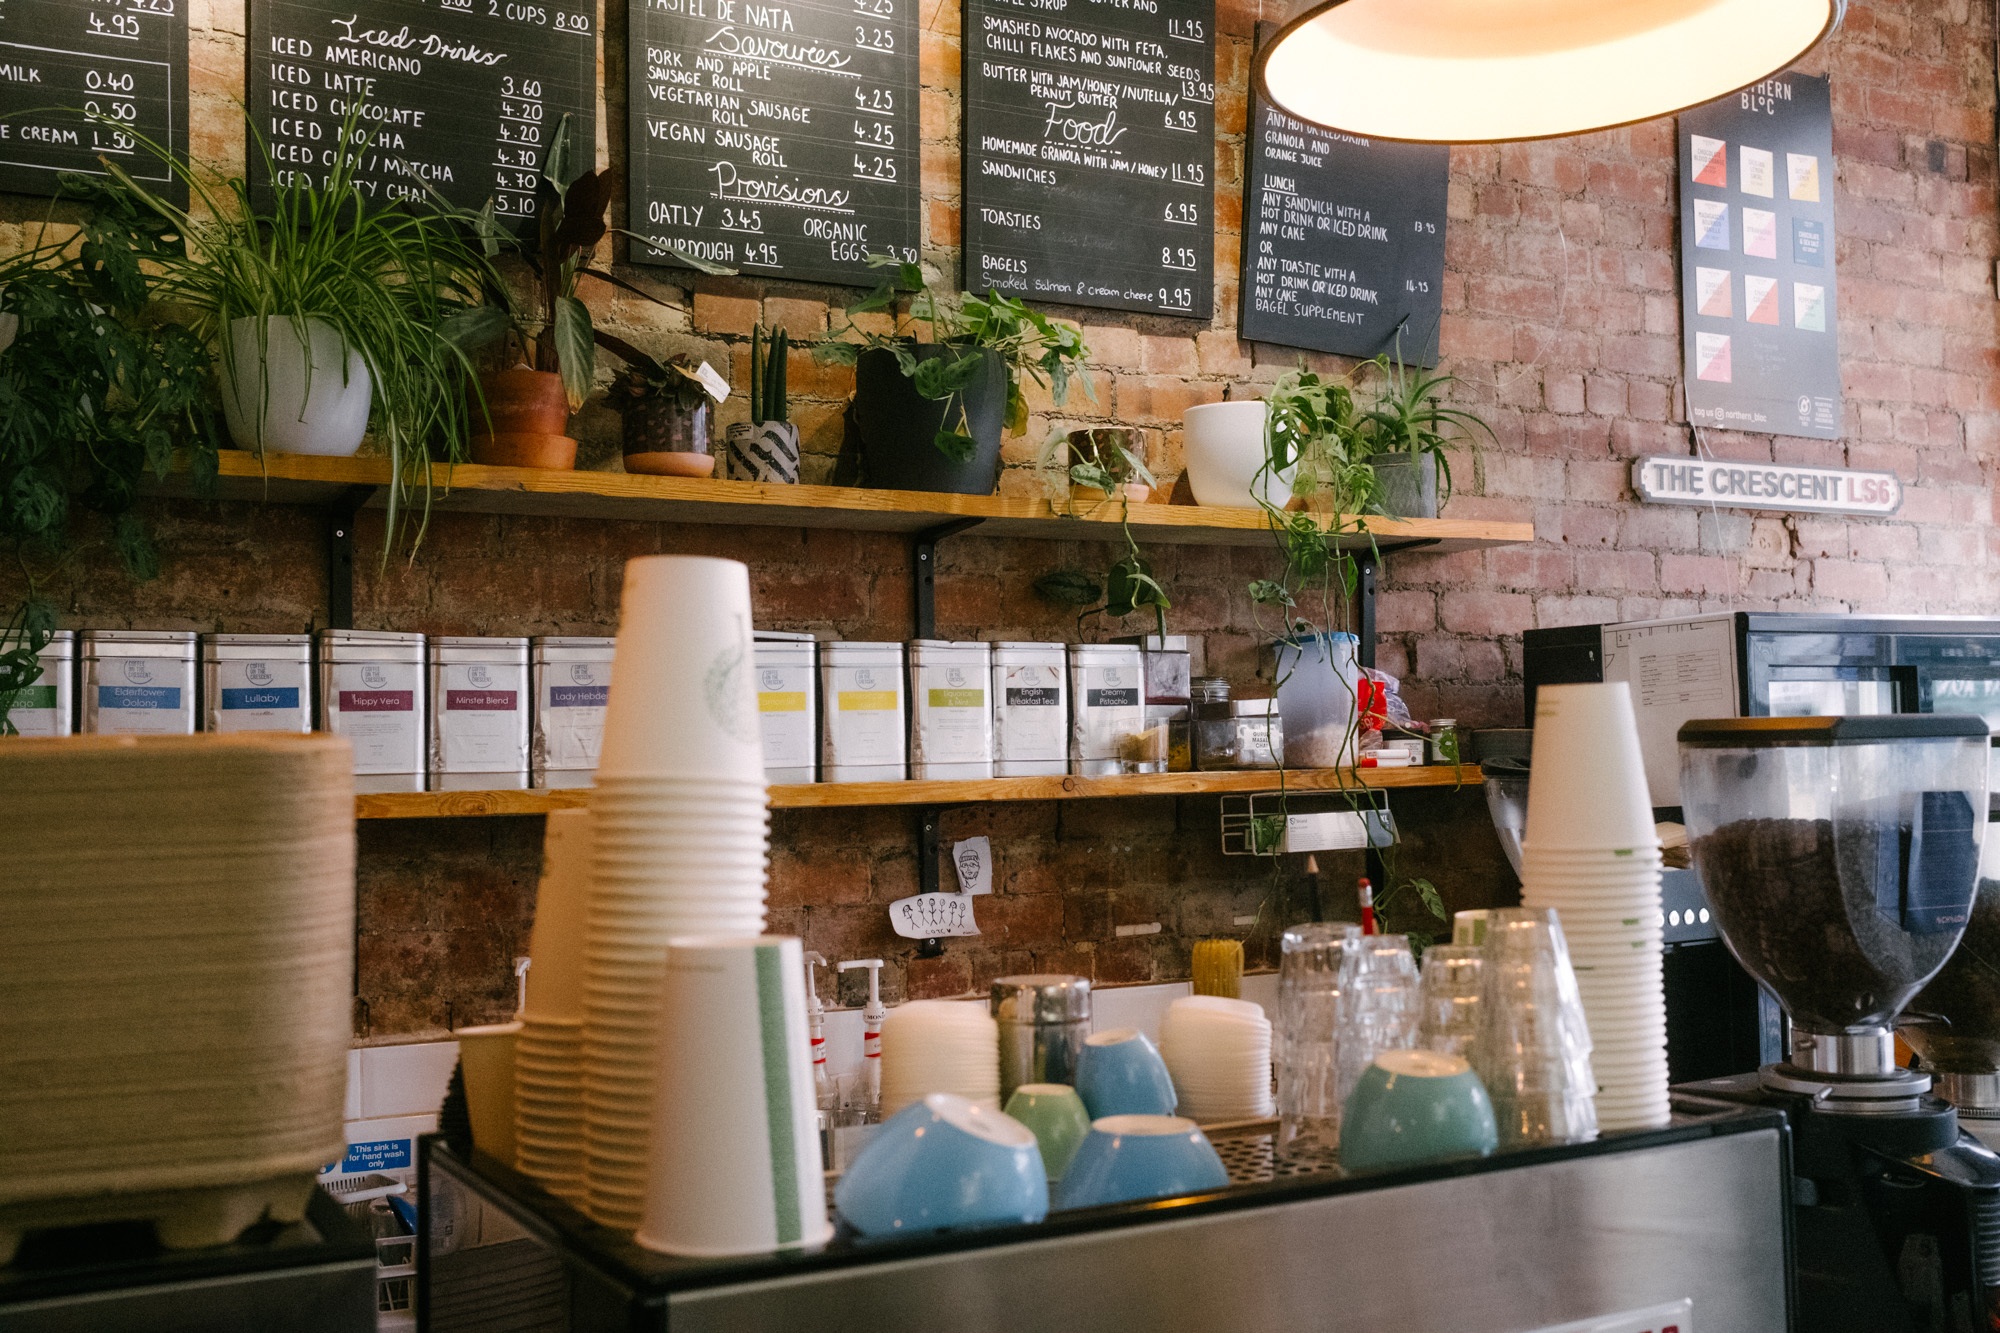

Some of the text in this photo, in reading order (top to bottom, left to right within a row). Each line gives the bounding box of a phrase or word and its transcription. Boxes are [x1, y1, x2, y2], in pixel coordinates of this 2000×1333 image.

[488, 0, 500, 16] 2
[506, 3, 546, 25] CUPS
[555, 12, 589, 30] 8.00
[717, 1, 736, 23] DE
[746, 6, 794, 32] NATA
[1133, 0, 1158, 14] AND
[89, 12, 140, 36] 4.95
[983, 16, 1130, 52] SMASHED AVOCADO WITH
[1169, 18, 1204, 39] 11.95
[331, 14, 508, 66] Iced Drinks
[705, 26, 851, 68] Savouries
[855, 26, 894, 48] 3.25
[271, 36, 422, 75] ICED AMERICANO
[647, 48, 771, 81] PORK AND APPLE
[986, 34, 1201, 82] CHILLI FLAKES AND SUNFLOWER SEEDS
[85, 70, 134, 91] 0.40
[271, 63, 377, 97] ICED LATTE
[647, 66, 744, 92] SAUSAGE ROLL
[983, 62, 1028, 83] BUTTER
[1031, 70, 1053, 86] WITH
[501, 76, 541, 97] 3.60
[855, 86, 894, 109] 4.25
[1030, 84, 1118, 109] PEANUT BUTTER
[1182, 81, 1215, 101] 13.95
[84, 101, 136, 120] 0.50
[272, 89, 425, 128] ICED CHOCOLATE
[502, 100, 542, 121] 4.20
[648, 84, 811, 124] VEGETARIAN SAUSAGE
[272, 117, 322, 140] ICED
[712, 109, 748, 128] ROLL
[1045, 102, 1128, 145] Food
[1164, 110, 1196, 128] 6.95
[1266, 111, 1287, 128] ANY
[20, 126, 136, 149] CREAM 1.50
[500, 124, 540, 143] 4.20
[647, 120, 780, 154] VEGAN SAUSAGE
[854, 120, 894, 145] 4.25
[1264, 130, 1330, 155] GRANOLA AND
[271, 143, 313, 164] ICED
[384, 157, 454, 183] MATCHA
[497, 148, 536, 166] 4.70
[752, 150, 787, 168] ROLL
[853, 154, 896, 179] 4.25
[981, 136, 1037, 157] HOMEMADE
[1041, 145, 1081, 165] GRANOLA
[1083, 153, 1107, 169] WITH
[1171, 162, 1205, 183] 11.95
[1265, 147, 1322, 168] ORANGE JUICE
[496, 172, 537, 190] 4.70
[708, 161, 850, 206] Provisions
[982, 160, 1056, 185] SANDWICHES
[1264, 173, 1296, 193] LUNCH
[495, 193, 536, 214] 5.10
[1164, 202, 1198, 222] 6.95
[1262, 192, 1371, 222] ANY SANDWICH WITH A
[649, 201, 868, 242] OATLY 3.45 ORGANIC
[980, 208, 1041, 230] TOASTIES
[1261, 205, 1388, 242] HOT DRINK OR ICED DRINK
[1414, 221, 1436, 234] 13.95
[1260, 221, 1306, 241] ANY CAKE
[648, 235, 778, 264] SOURDOUGH 4.95
[831, 241, 869, 262] EGGS
[1161, 246, 1196, 268] 8.95
[1259, 240, 1274, 256] OR
[982, 254, 1028, 274] BAGELS
[1257, 256, 1356, 283] ANY TOASTIE WITH A
[982, 272, 1192, 307] Smoked Salmon & cream cheese 9.95
[1255, 285, 1298, 303] ANY CAKE
[1256, 271, 1379, 306] HOT DRINK OR ICED DRINK
[1405, 279, 1429, 294] 14.95
[1255, 298, 1365, 326] BAGEL SUPPLEMENT
[1695, 407, 1706, 418] tag
[1706, 409, 1714, 417] us
[1653, 463, 1891, 505] THE CRESCENT LS6
[114, 687, 166, 697] Elderflower
[245, 694, 280, 704] Lullaby
[379, 697, 400, 705] Vera
[456, 696, 509, 705] Minster Blend
[555, 692, 577, 702] Lady
[1010, 697, 1055, 705] Breakfast Tea
[1021, 689, 1044, 697] English
[1100, 689, 1127, 698] Creamy
[122, 698, 158, 709] Oolong
[349, 1150, 405, 1162] for hand wash
[355, 1142, 399, 1153] This sink is
[368, 1159, 385, 1168] only
